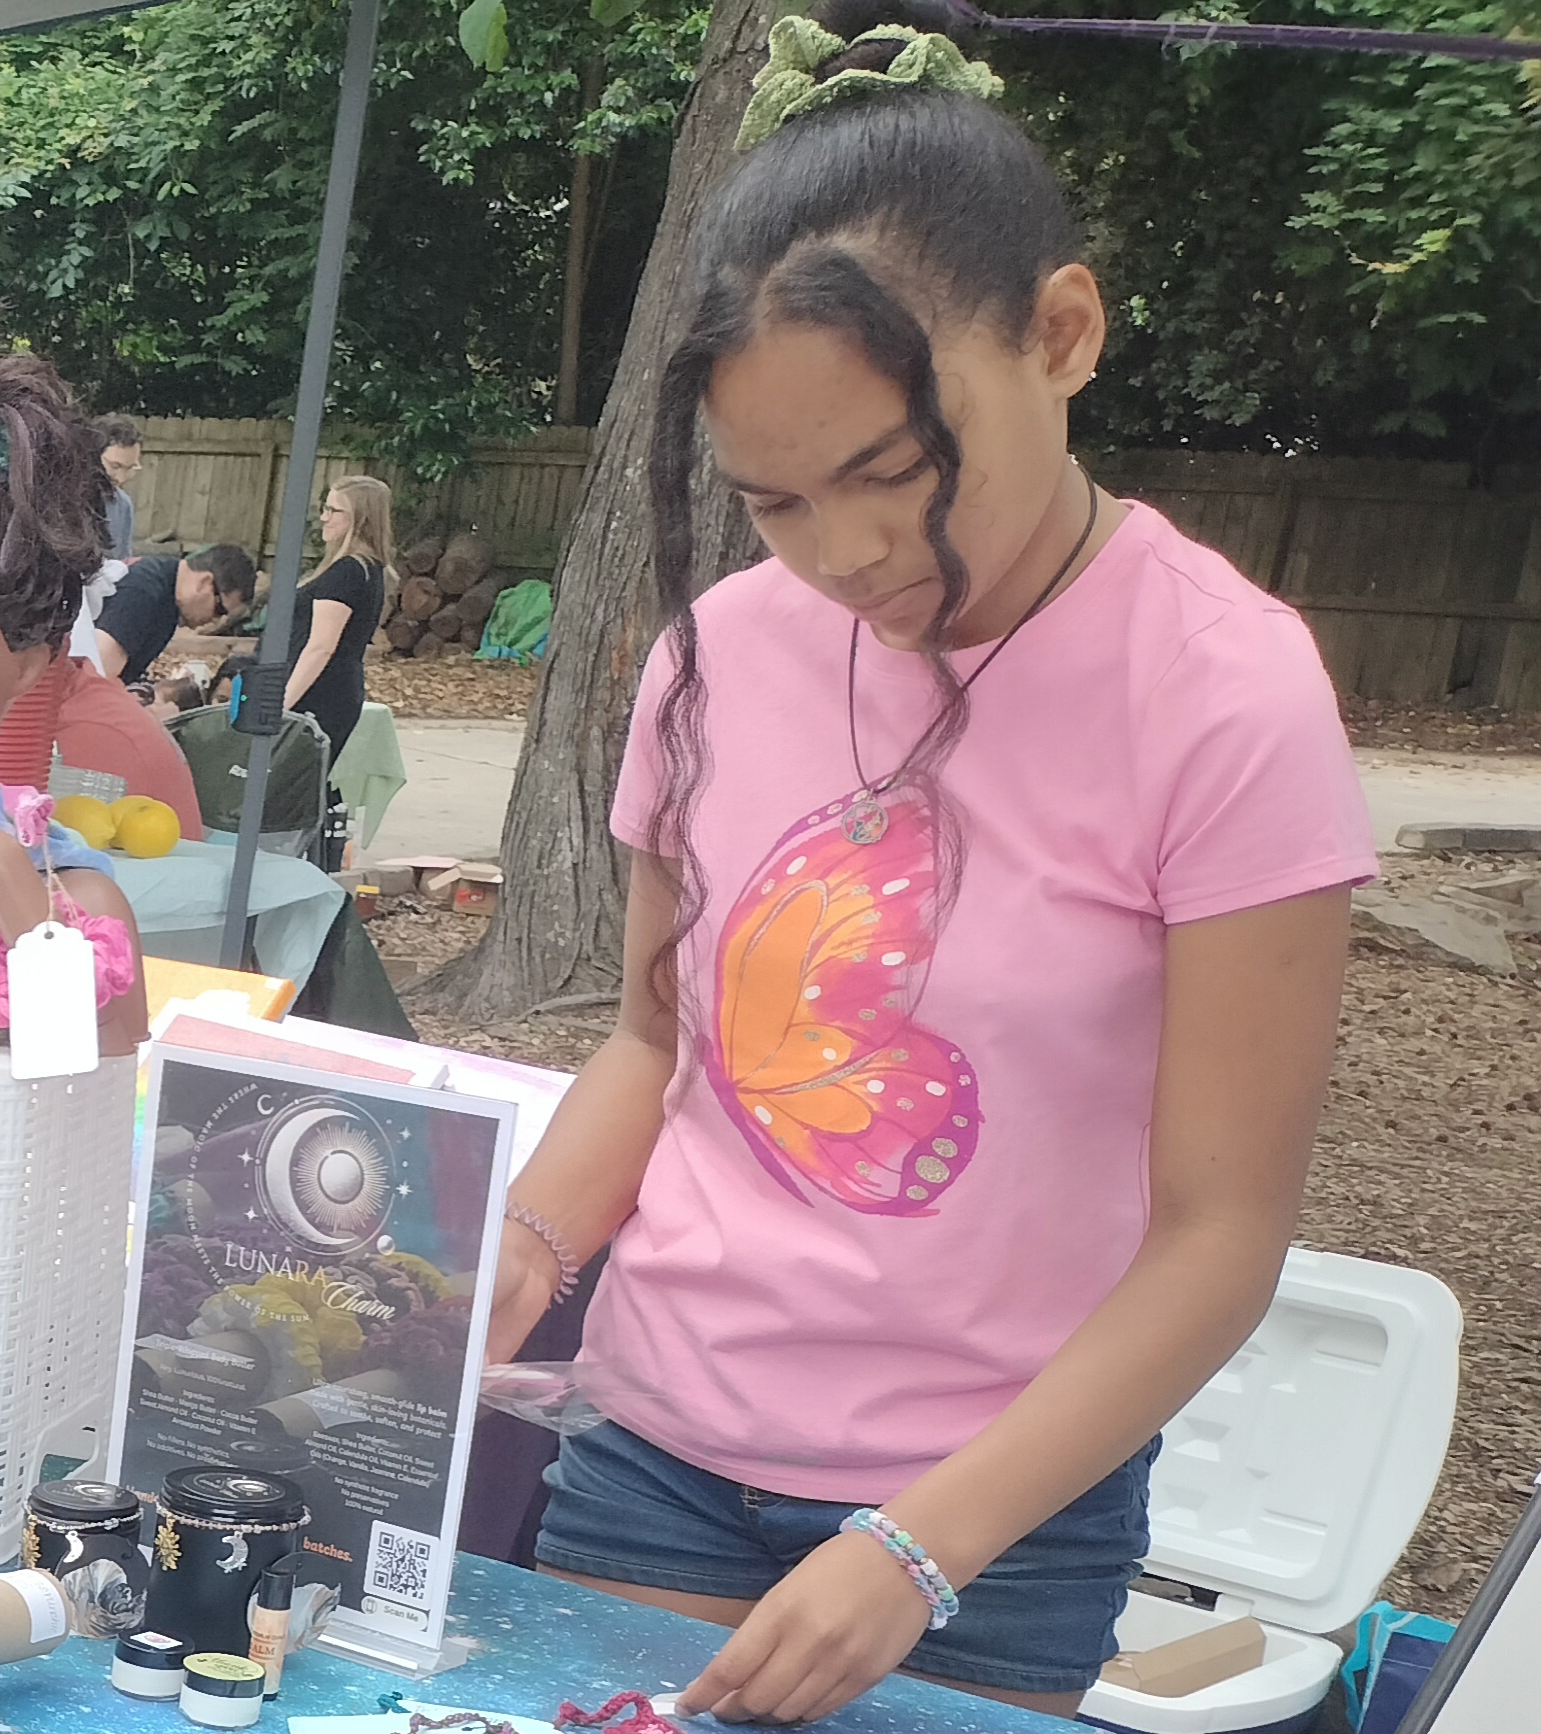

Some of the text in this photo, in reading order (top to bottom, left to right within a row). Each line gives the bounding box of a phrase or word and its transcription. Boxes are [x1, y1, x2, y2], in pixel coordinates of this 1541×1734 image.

[213, 1101, 230, 1121] THE
[193, 1119, 214, 1154] MAGIC
[185, 1198, 199, 1231] MOON
[190, 1233, 212, 1267] MEETS
[208, 1265, 225, 1286] THE
[224, 1243, 329, 1288] LUNARA
[321, 1280, 396, 1321] Charm
[268, 1312, 288, 1323] THE
[428, 1406, 448, 1418] balm
[399, 1422, 415, 1433] and
[415, 1425, 443, 1440] protect
[303, 1536, 354, 1563] batches.
[383, 1605, 420, 1624] Scan Me
